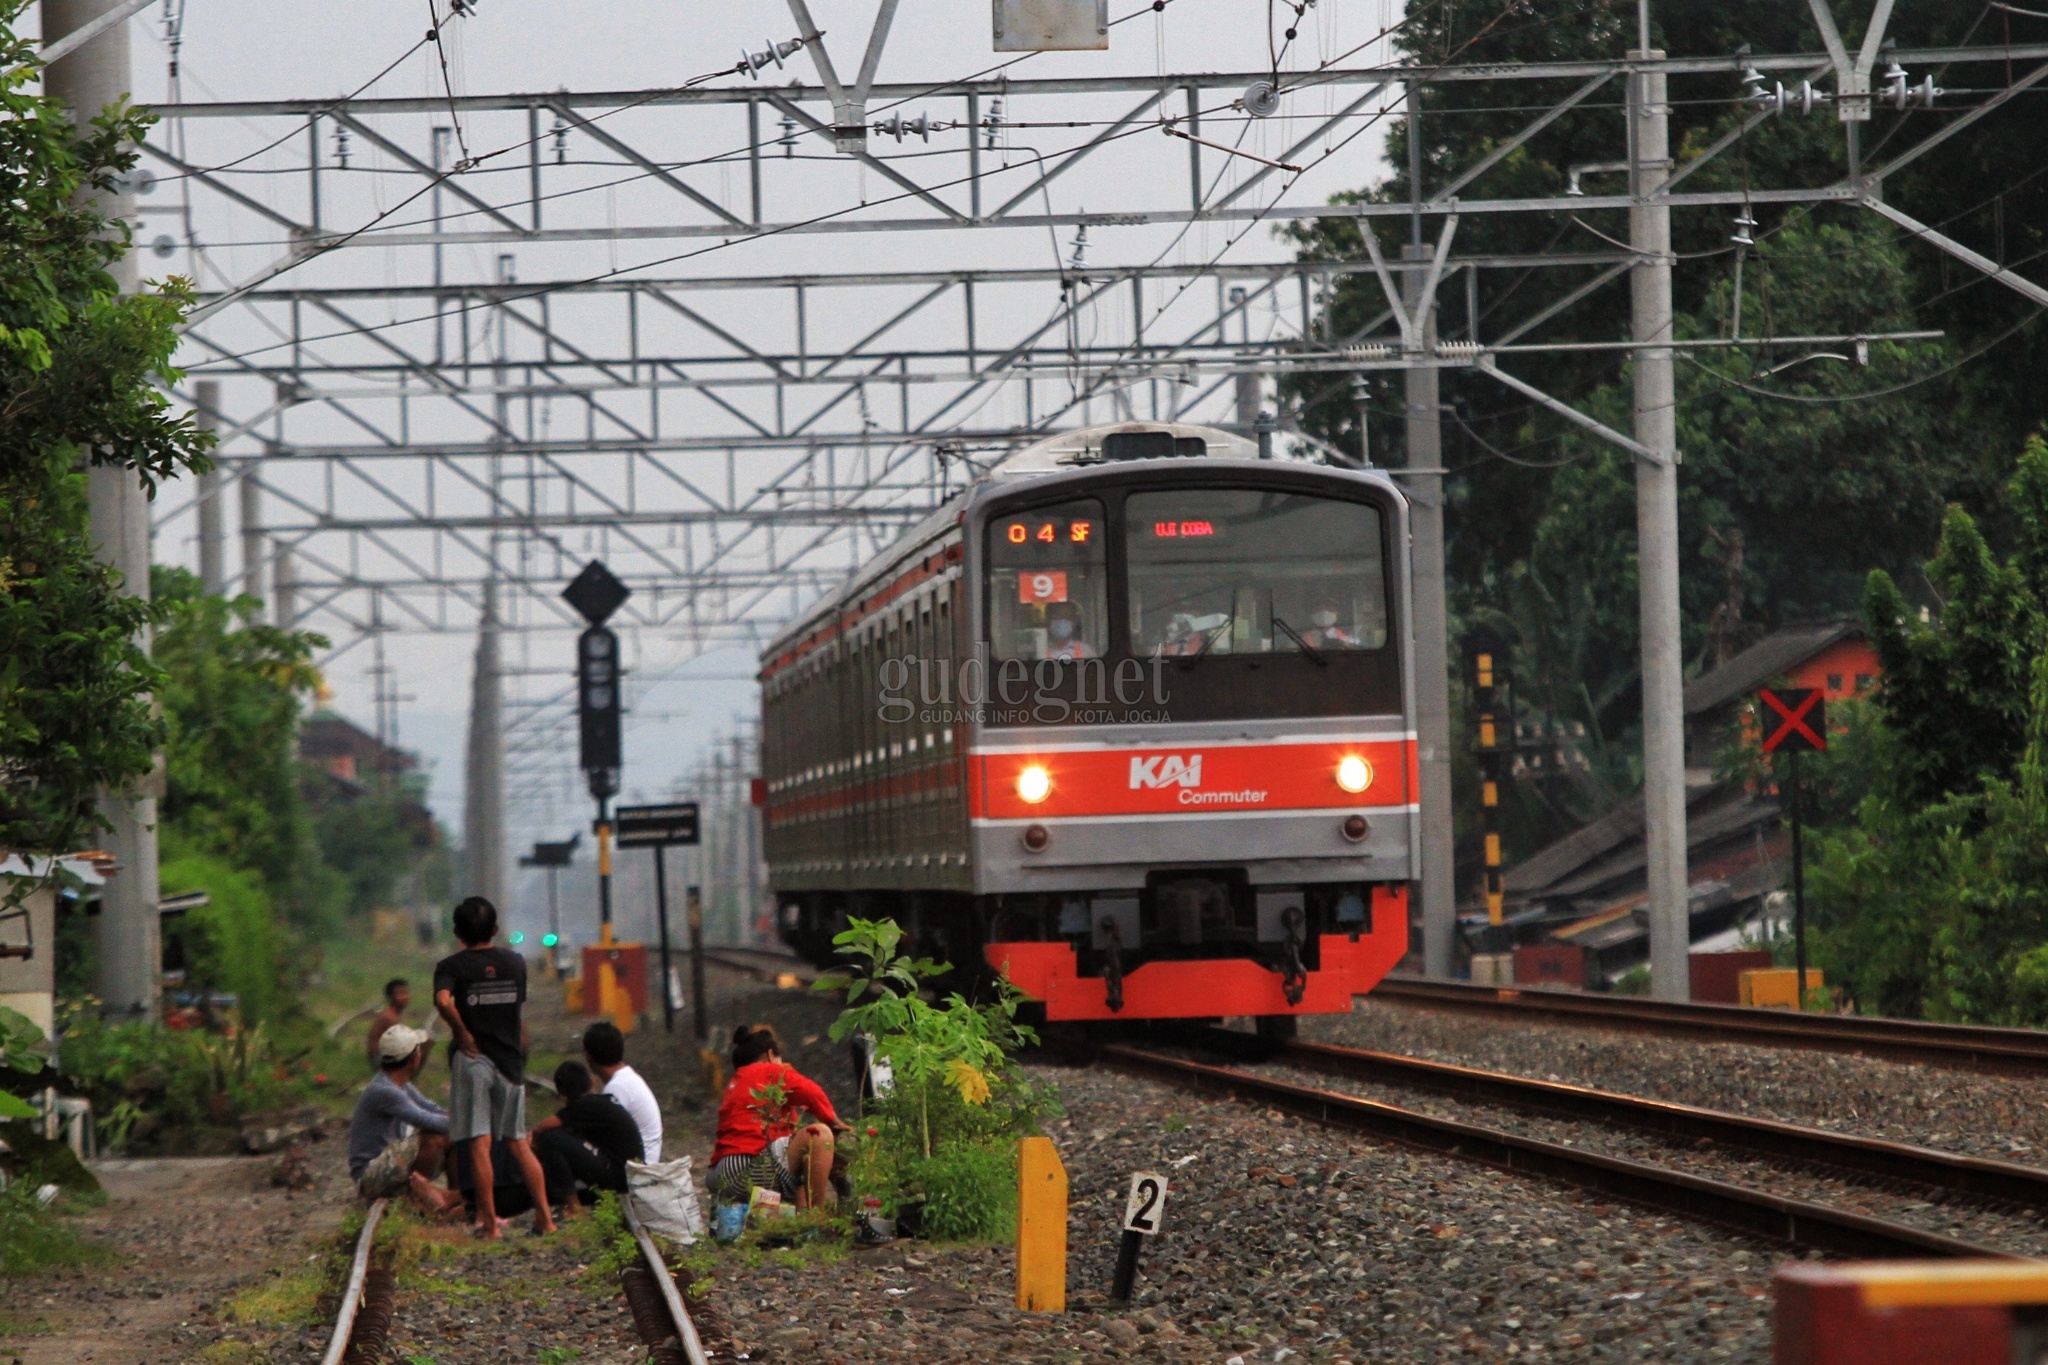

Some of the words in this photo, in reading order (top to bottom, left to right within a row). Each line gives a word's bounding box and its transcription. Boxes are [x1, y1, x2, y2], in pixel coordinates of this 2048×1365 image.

[1032, 575, 1054, 598] 9
[1129, 754, 1202, 789] KAI
[1178, 788, 1267, 804] Commuter
[1131, 1178, 1160, 1230] 2
